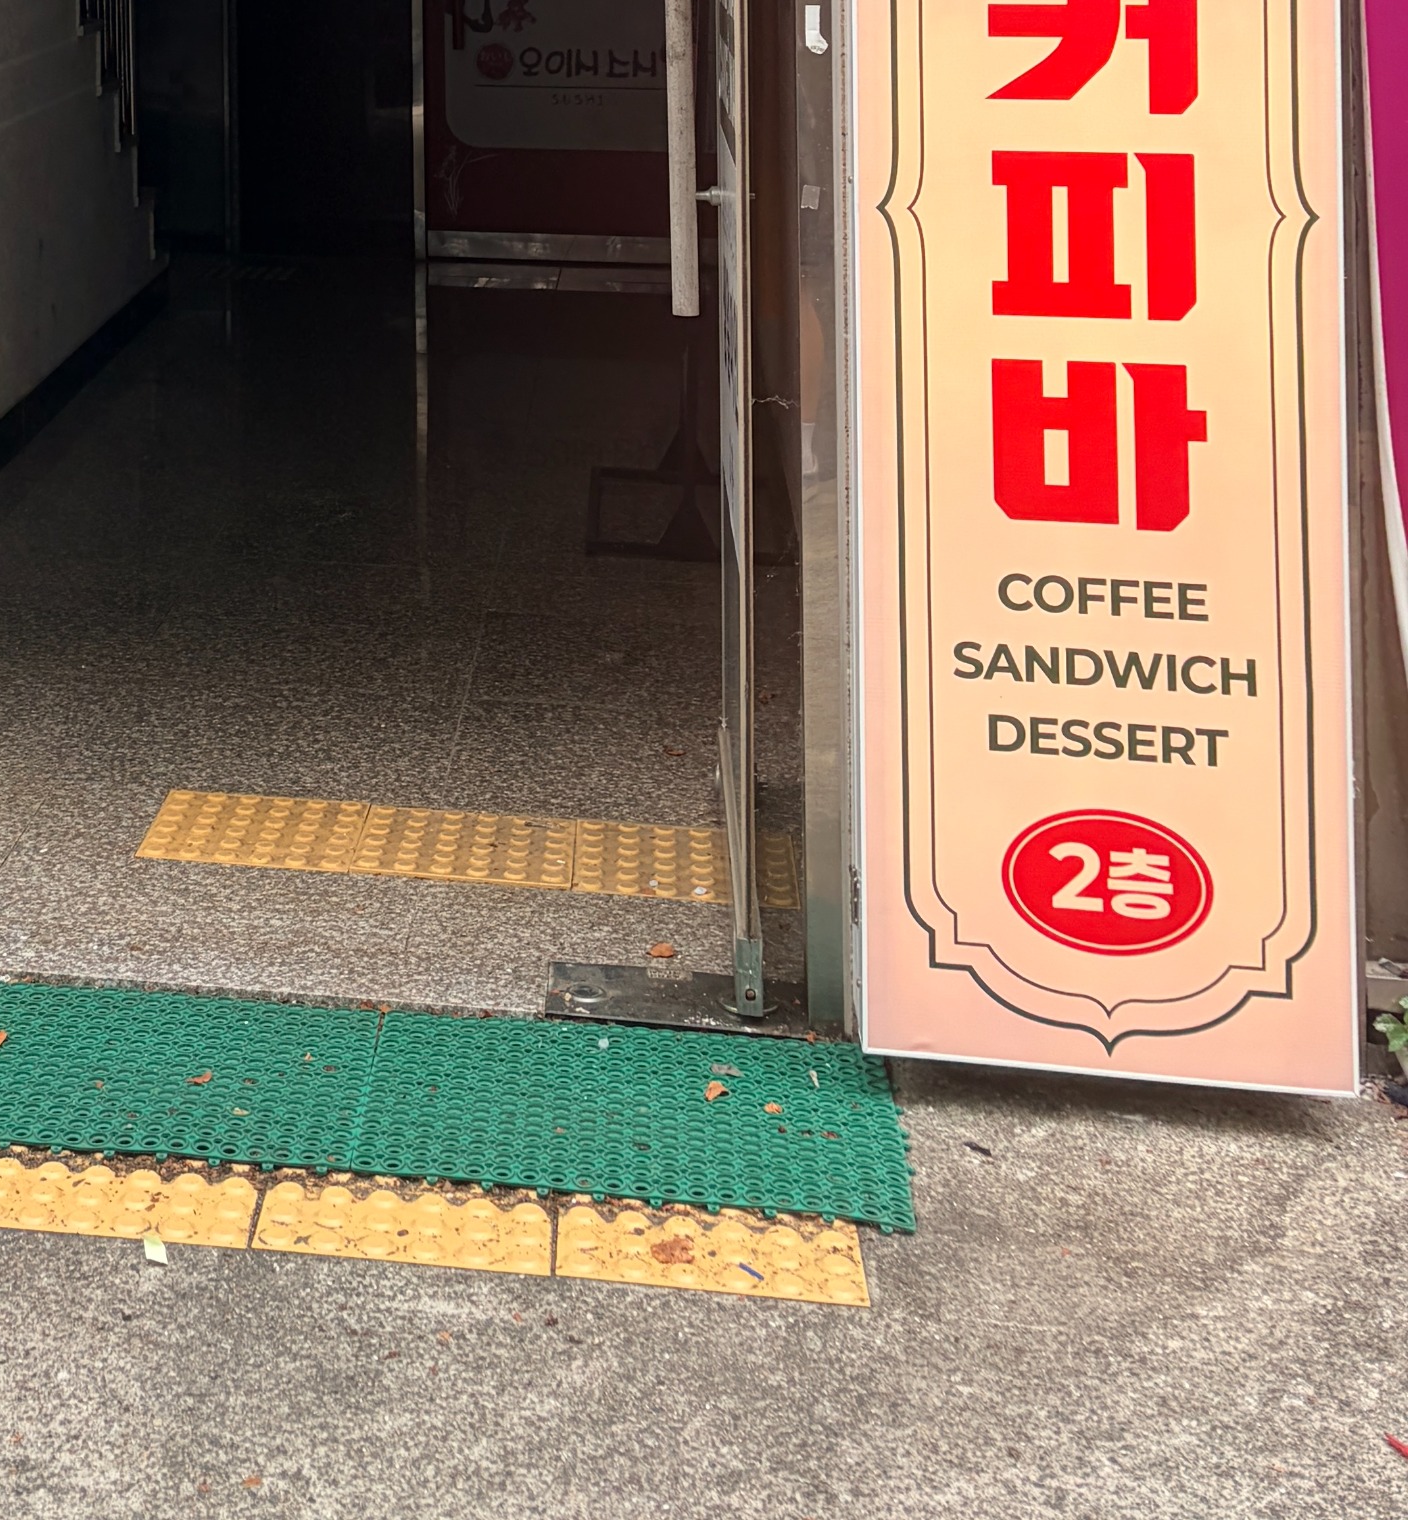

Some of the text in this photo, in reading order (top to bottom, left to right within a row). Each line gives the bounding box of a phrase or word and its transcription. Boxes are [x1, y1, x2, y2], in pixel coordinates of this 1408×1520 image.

[997, 573, 1210, 623] COFFEE
[953, 640, 1259, 699] SANDWICH
[987, 713, 1229, 768] DESSERT
[1048, 841, 1176, 922] 2층
